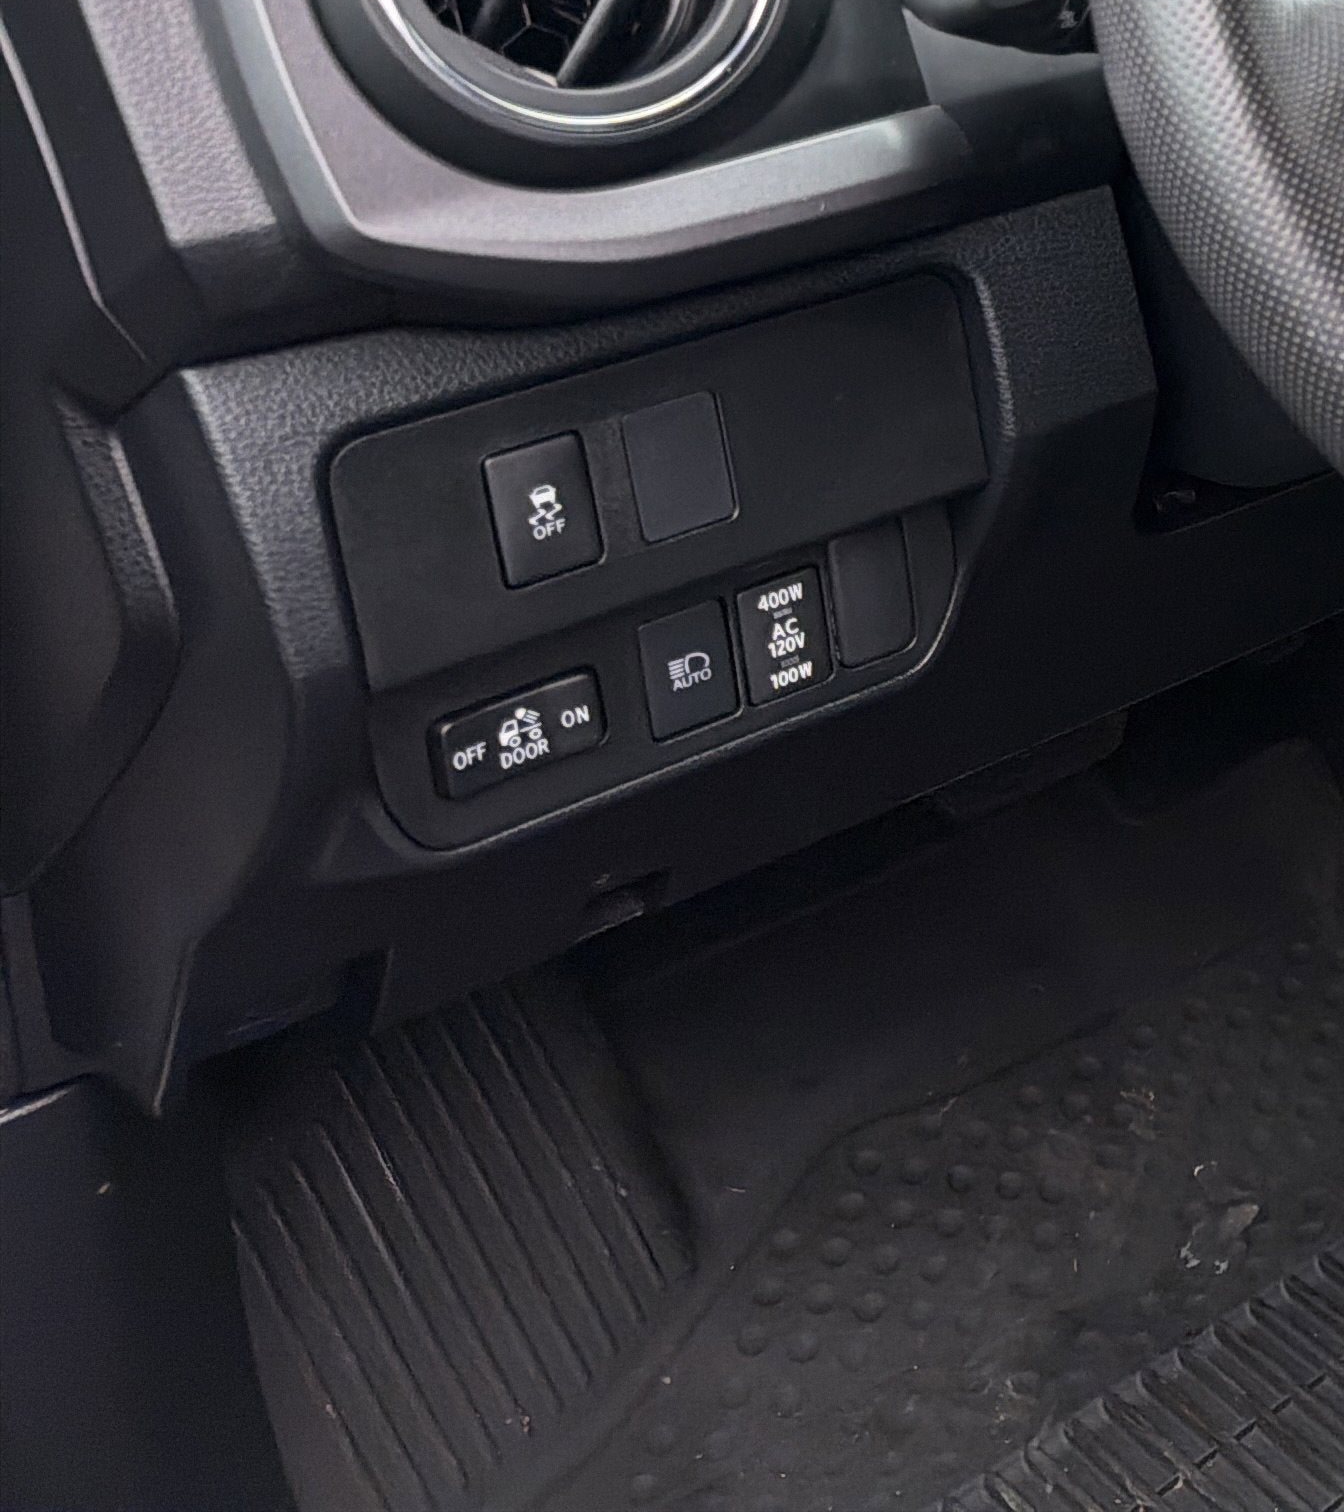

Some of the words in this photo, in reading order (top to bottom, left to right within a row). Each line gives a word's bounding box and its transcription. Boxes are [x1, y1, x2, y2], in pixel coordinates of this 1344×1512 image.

[533, 518, 566, 540] OFF
[757, 582, 803, 612] 400W
[772, 618, 800, 640] AC
[768, 632, 806, 658] 120V
[672, 668, 712, 692] AUTO
[770, 661, 813, 689] 100W
[560, 705, 590, 729] ON
[453, 742, 487, 770] OFF
[500, 739, 550, 769] DOOR
